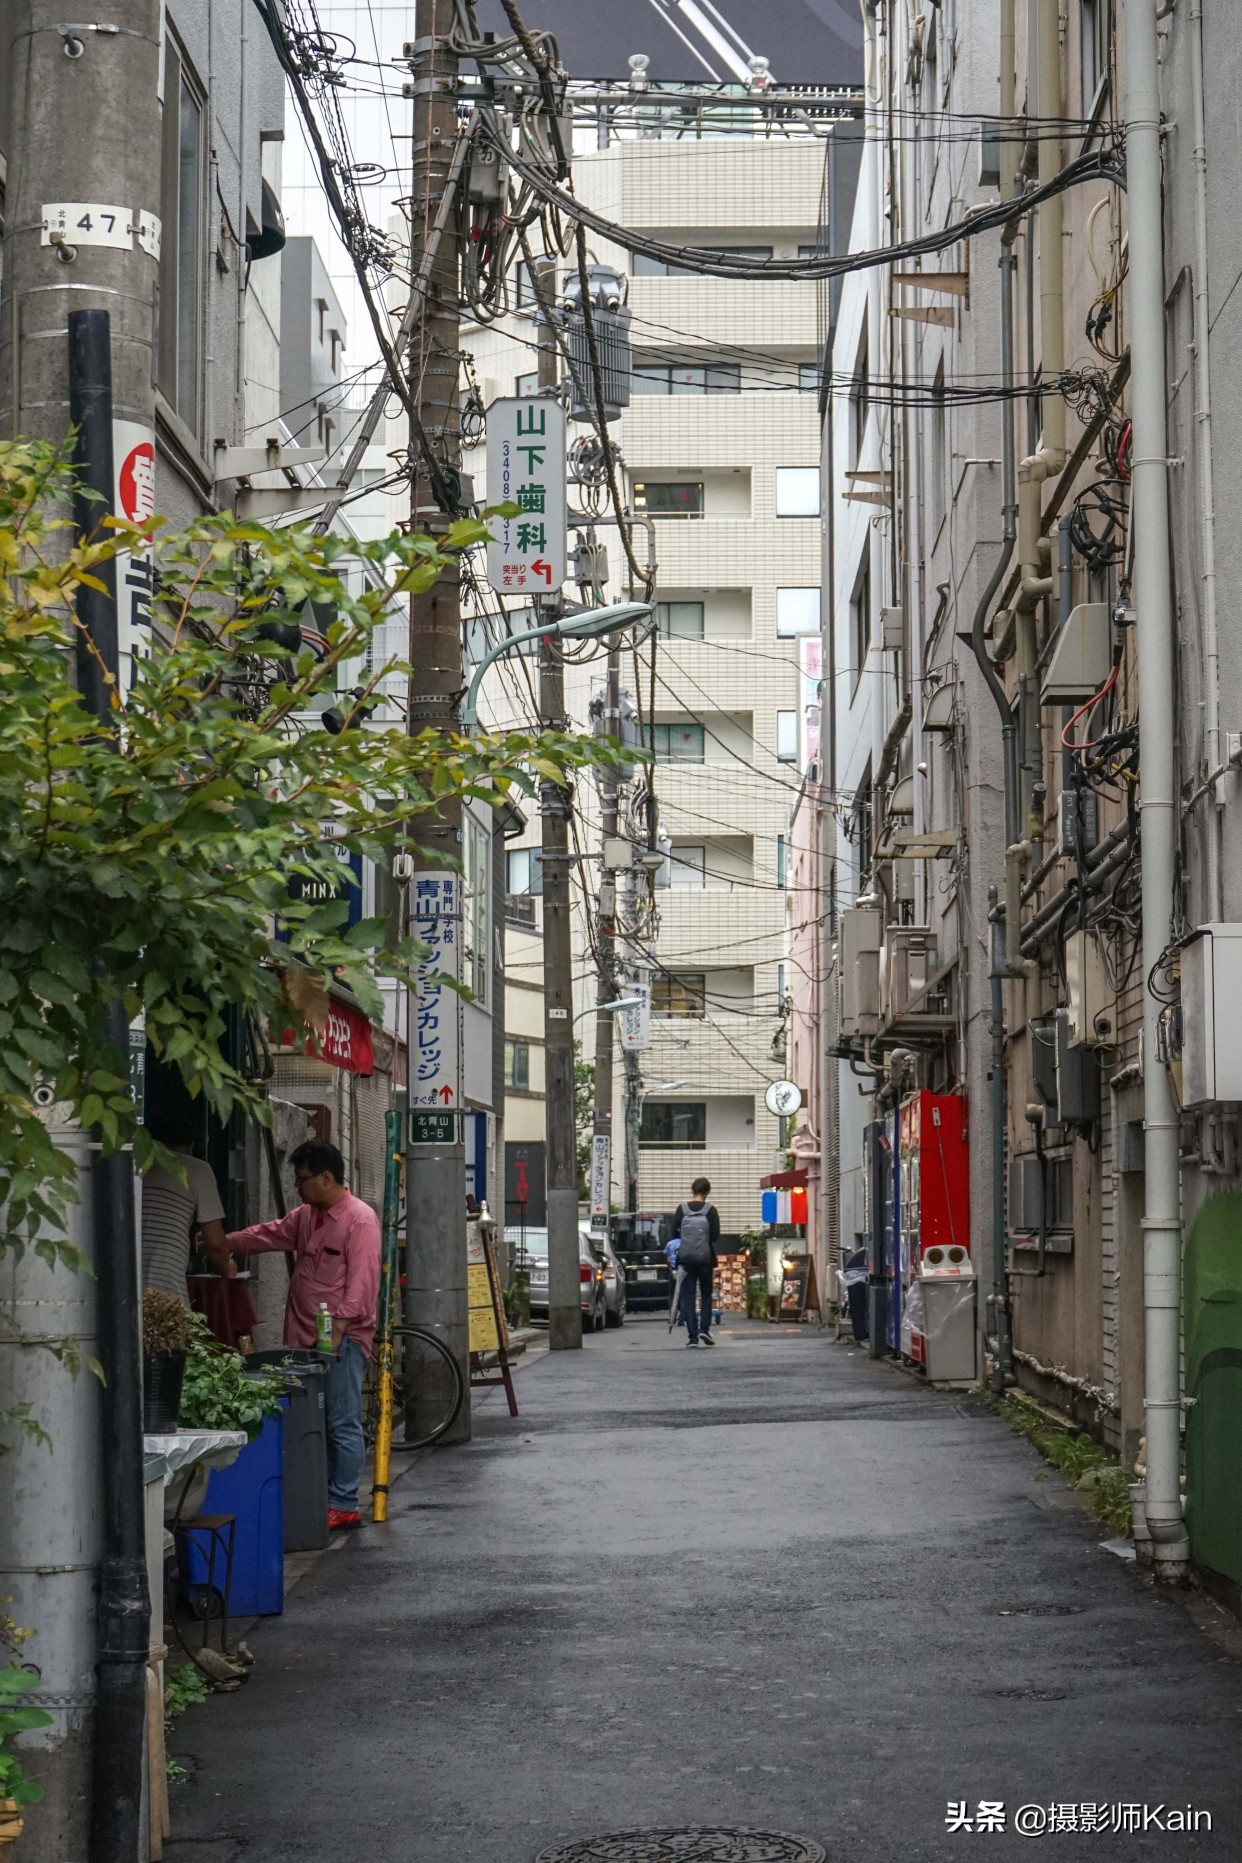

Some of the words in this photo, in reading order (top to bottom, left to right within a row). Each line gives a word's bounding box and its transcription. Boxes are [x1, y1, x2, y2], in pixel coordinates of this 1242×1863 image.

[77, 212, 116, 233] 47
[516, 405, 547, 554] 山下歯科
[502, 440, 511, 554] (3408)317
[502, 564, 527, 574] 突当り
[502, 575, 527, 585] 左手
[302, 883, 336, 898] MINX
[443, 880, 454, 944] 専門学校
[412, 1096, 437, 1105] すぐ先
[418, 1116, 449, 1126] 北青山
[421, 1129, 444, 1138] 3-5
